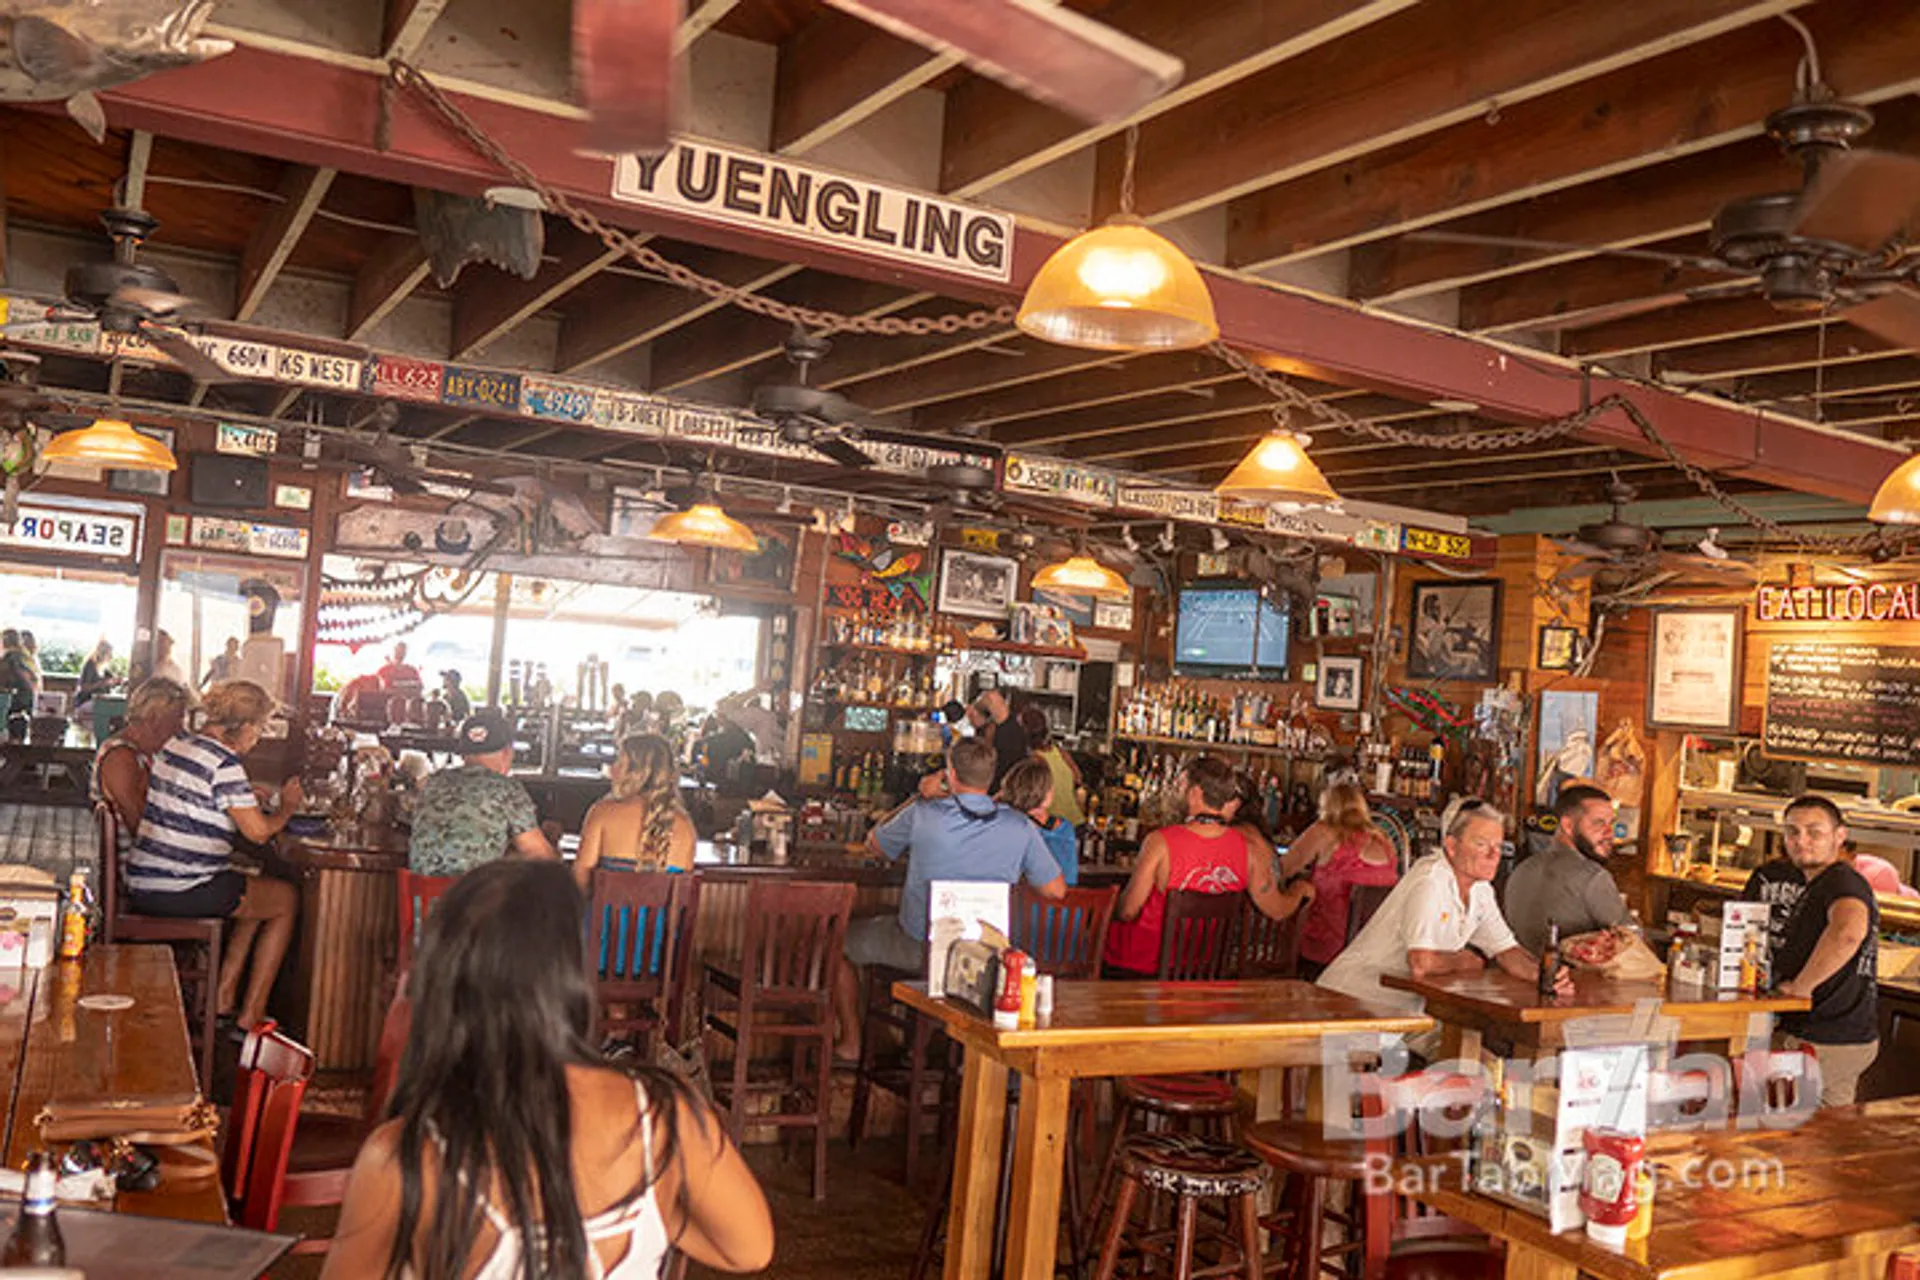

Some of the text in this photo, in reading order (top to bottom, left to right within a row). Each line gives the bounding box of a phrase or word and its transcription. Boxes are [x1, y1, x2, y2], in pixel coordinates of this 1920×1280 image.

[634, 147, 1004, 268] YUENGLING
[279, 351, 355, 383] KS WEST
[1759, 583, 1920, 621] EAT LOCAL
